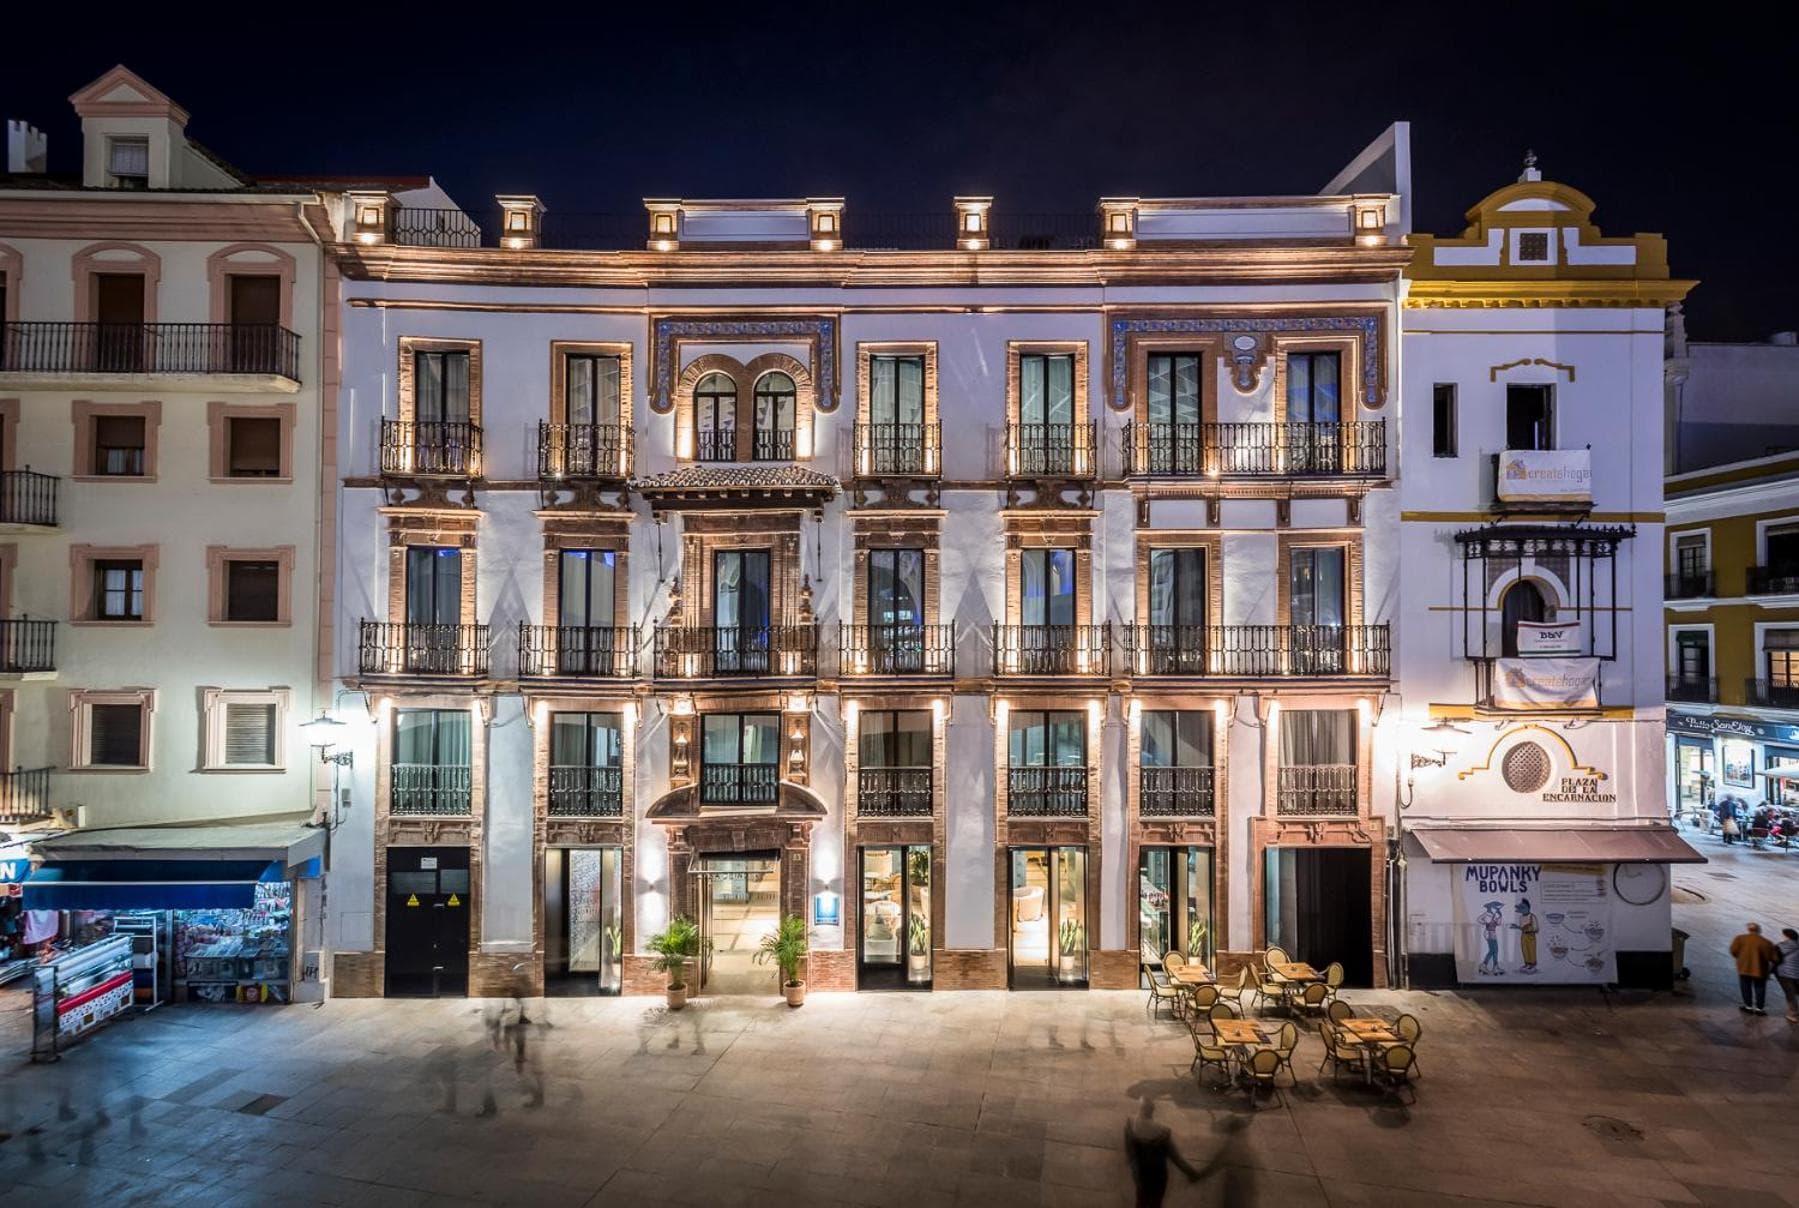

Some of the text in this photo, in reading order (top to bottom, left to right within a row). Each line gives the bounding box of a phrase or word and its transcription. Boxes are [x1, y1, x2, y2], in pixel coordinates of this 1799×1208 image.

[1561, 777, 1597, 786] PLAZA
[1561, 785, 1597, 794] DE LA
[1542, 793, 1616, 803] ENCARNACION
[1466, 865, 1541, 881] MUPANKY
[1479, 880, 1528, 893] BOWLS
